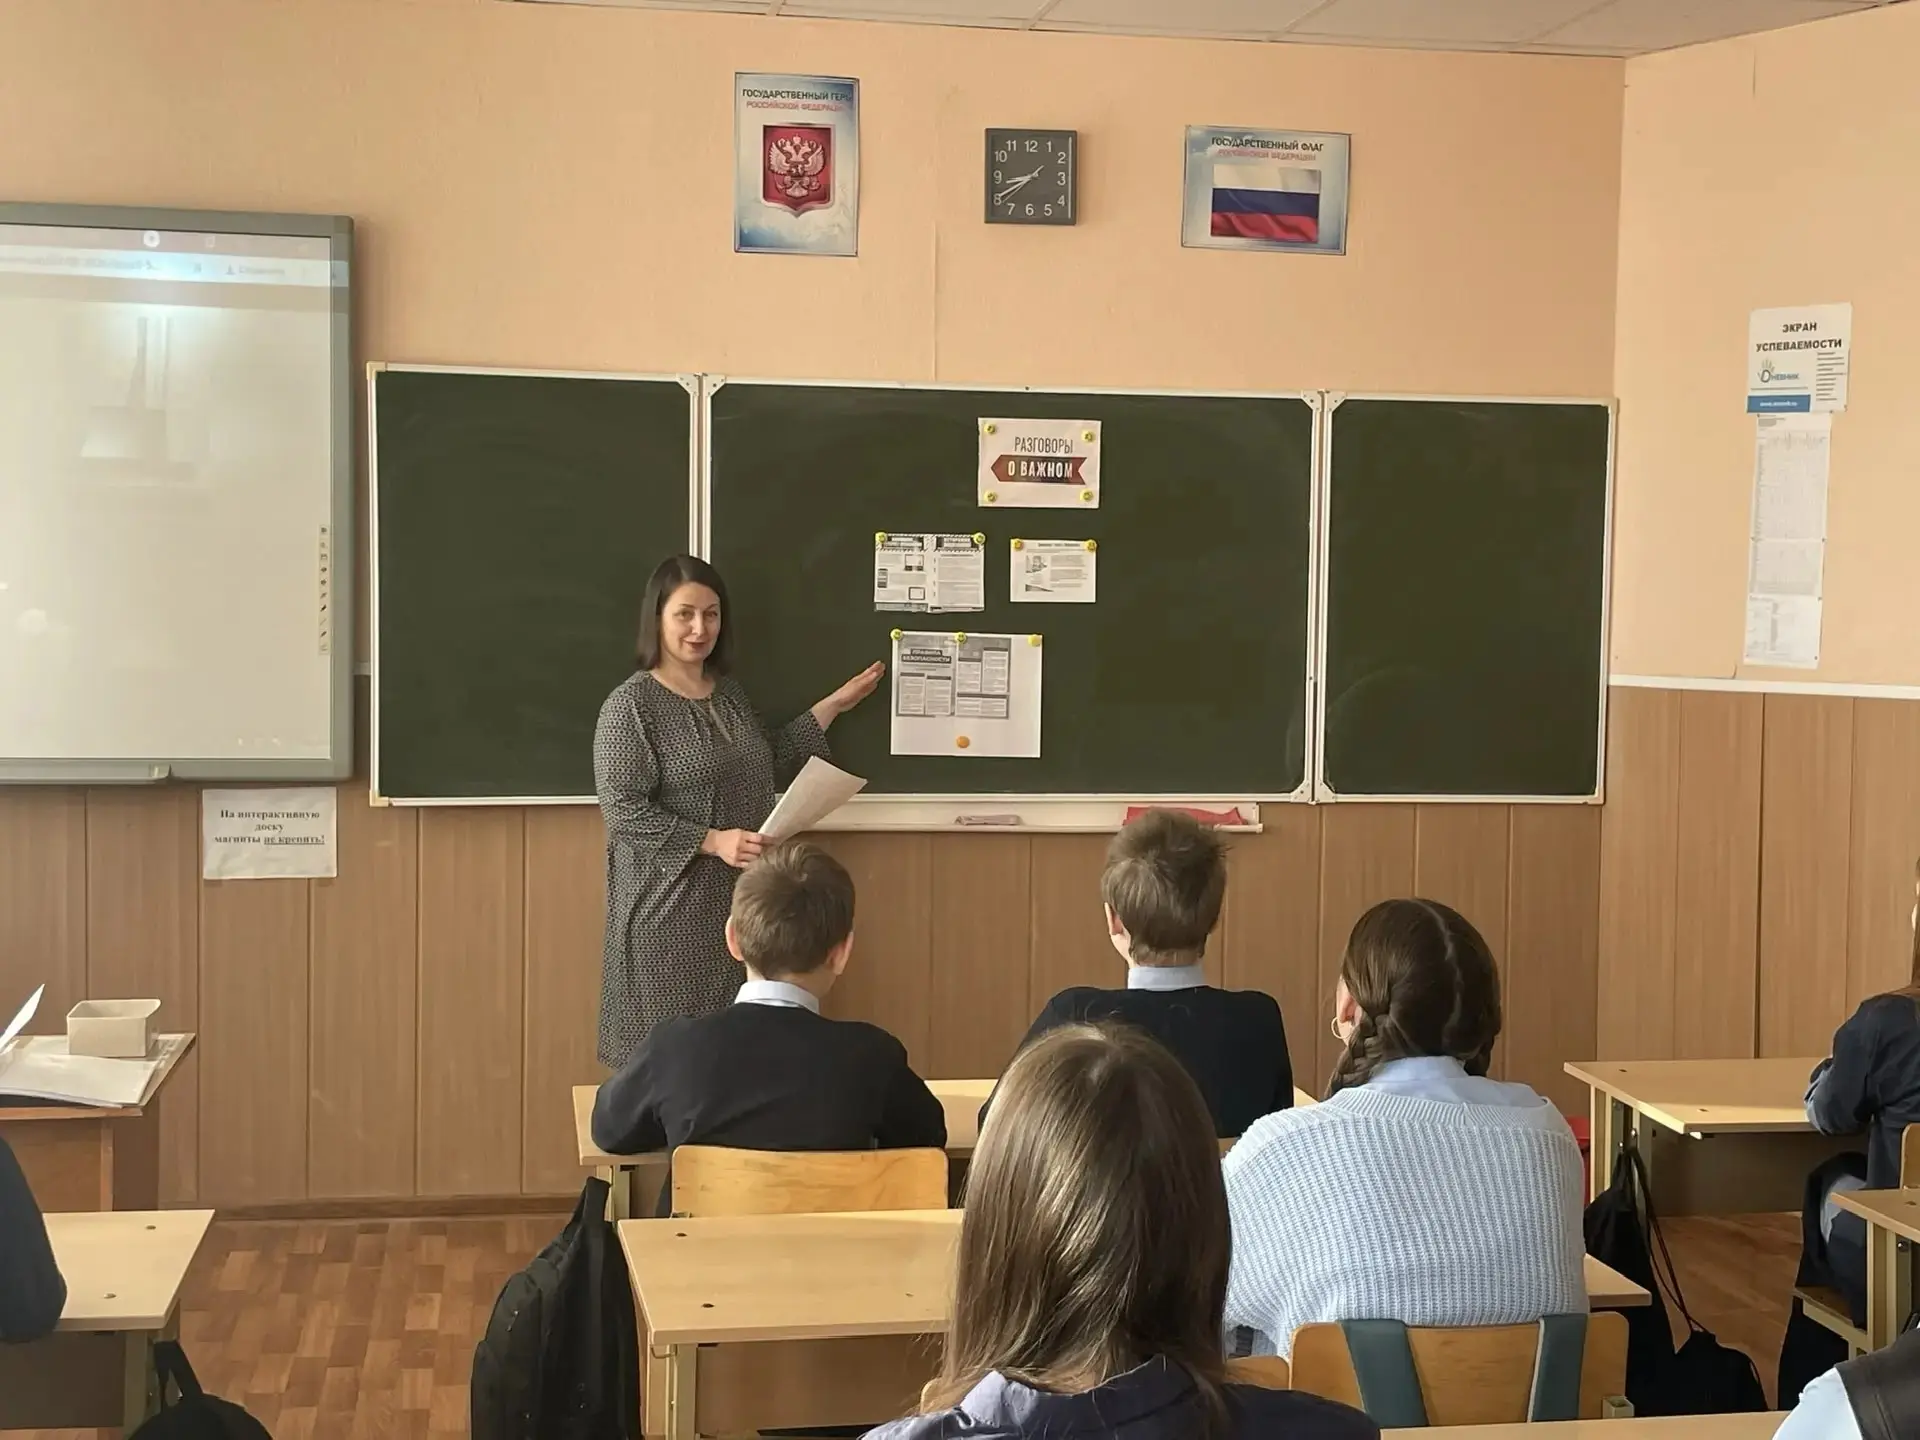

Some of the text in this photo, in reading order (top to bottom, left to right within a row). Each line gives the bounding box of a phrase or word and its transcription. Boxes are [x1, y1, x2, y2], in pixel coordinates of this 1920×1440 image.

[742, 88, 829, 100] ГОСУДАРСТВЕННЫЙ
[1006, 140, 1017, 151] 11
[1024, 140, 1038, 152] 12
[1046, 141, 1052, 152] 1
[1212, 136, 1324, 152] ГОСУДАРСТВЕННЫЙ ФЛАГ
[994, 150, 1008, 162] 10
[1057, 152, 1066, 164] 2
[993, 170, 1002, 184] 9
[1057, 172, 1066, 185] 3
[993, 193, 1002, 206] 8
[1057, 195, 1065, 207] 4
[1007, 203, 1016, 215] 7
[1025, 203, 1034, 216] 6
[1043, 203, 1052, 216] 5
[1782, 322, 1818, 334] ЭКРАН
[1756, 338, 1842, 352] УСПЕВАЕМОСТИ
[1014, 436, 1073, 453] РАЗГОВОРЫ
[1008, 460, 1073, 478] О ВАЖНОМ
[220, 809, 320, 821] На интерактивную
[254, 823, 284, 833] доску
[215, 834, 325, 845] магниты не крепить!
